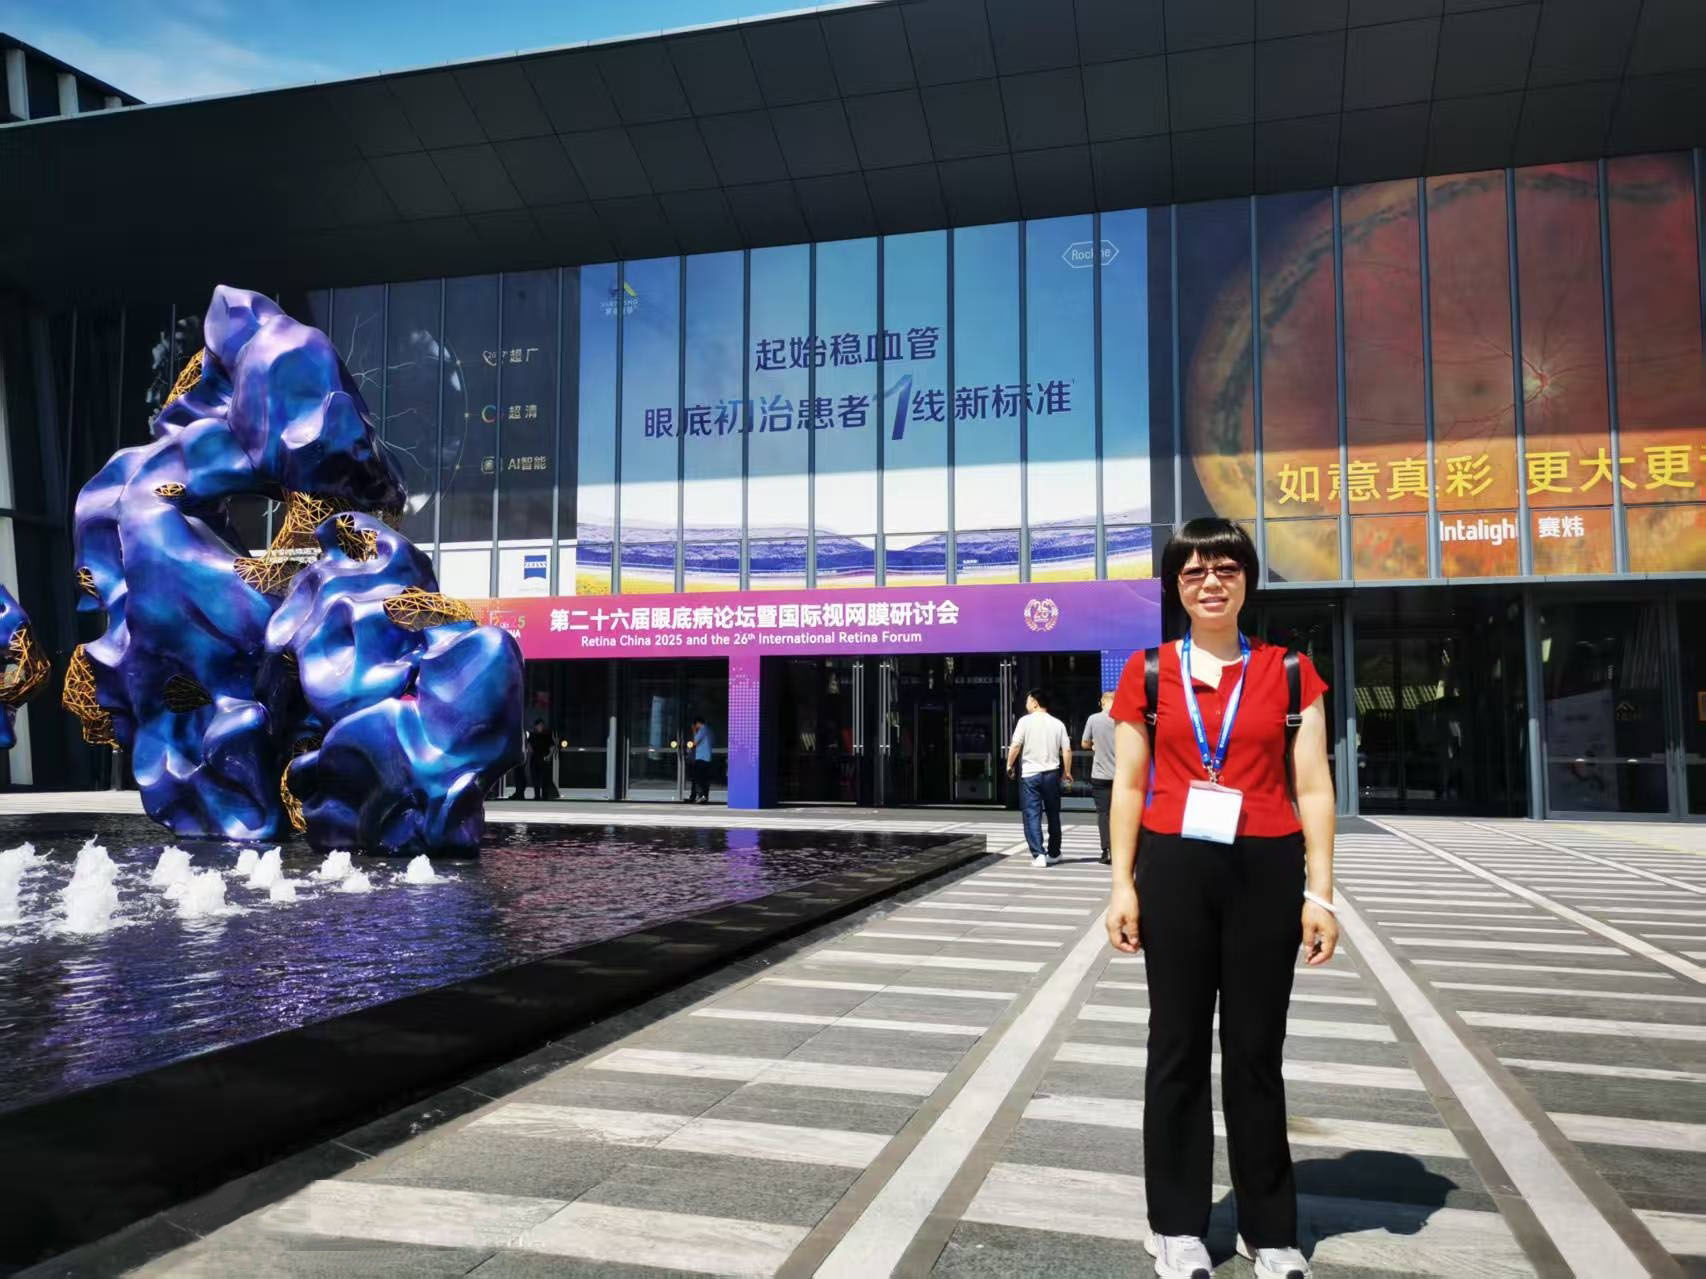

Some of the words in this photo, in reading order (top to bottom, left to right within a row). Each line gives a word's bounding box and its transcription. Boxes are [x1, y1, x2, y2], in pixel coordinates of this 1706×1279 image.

[755, 325, 940, 372] 起始稳血管
[507, 456, 547, 471] AI智能
[1278, 453, 1494, 505] 如意真彩
[1525, 444, 1706, 496] 更大更
[549, 599, 960, 632] 第二十六届眼底病论坛暨国际视网膜研讨会
[581, 634, 617, 647] Retina
[620, 634, 651, 647] China
[655, 634, 683, 646] 2025
[686, 633, 708, 646] and
[711, 632, 730, 645] the
[758, 631, 835, 645] International
[839, 631, 878, 644] Retina
[882, 630, 922, 643] Forum
